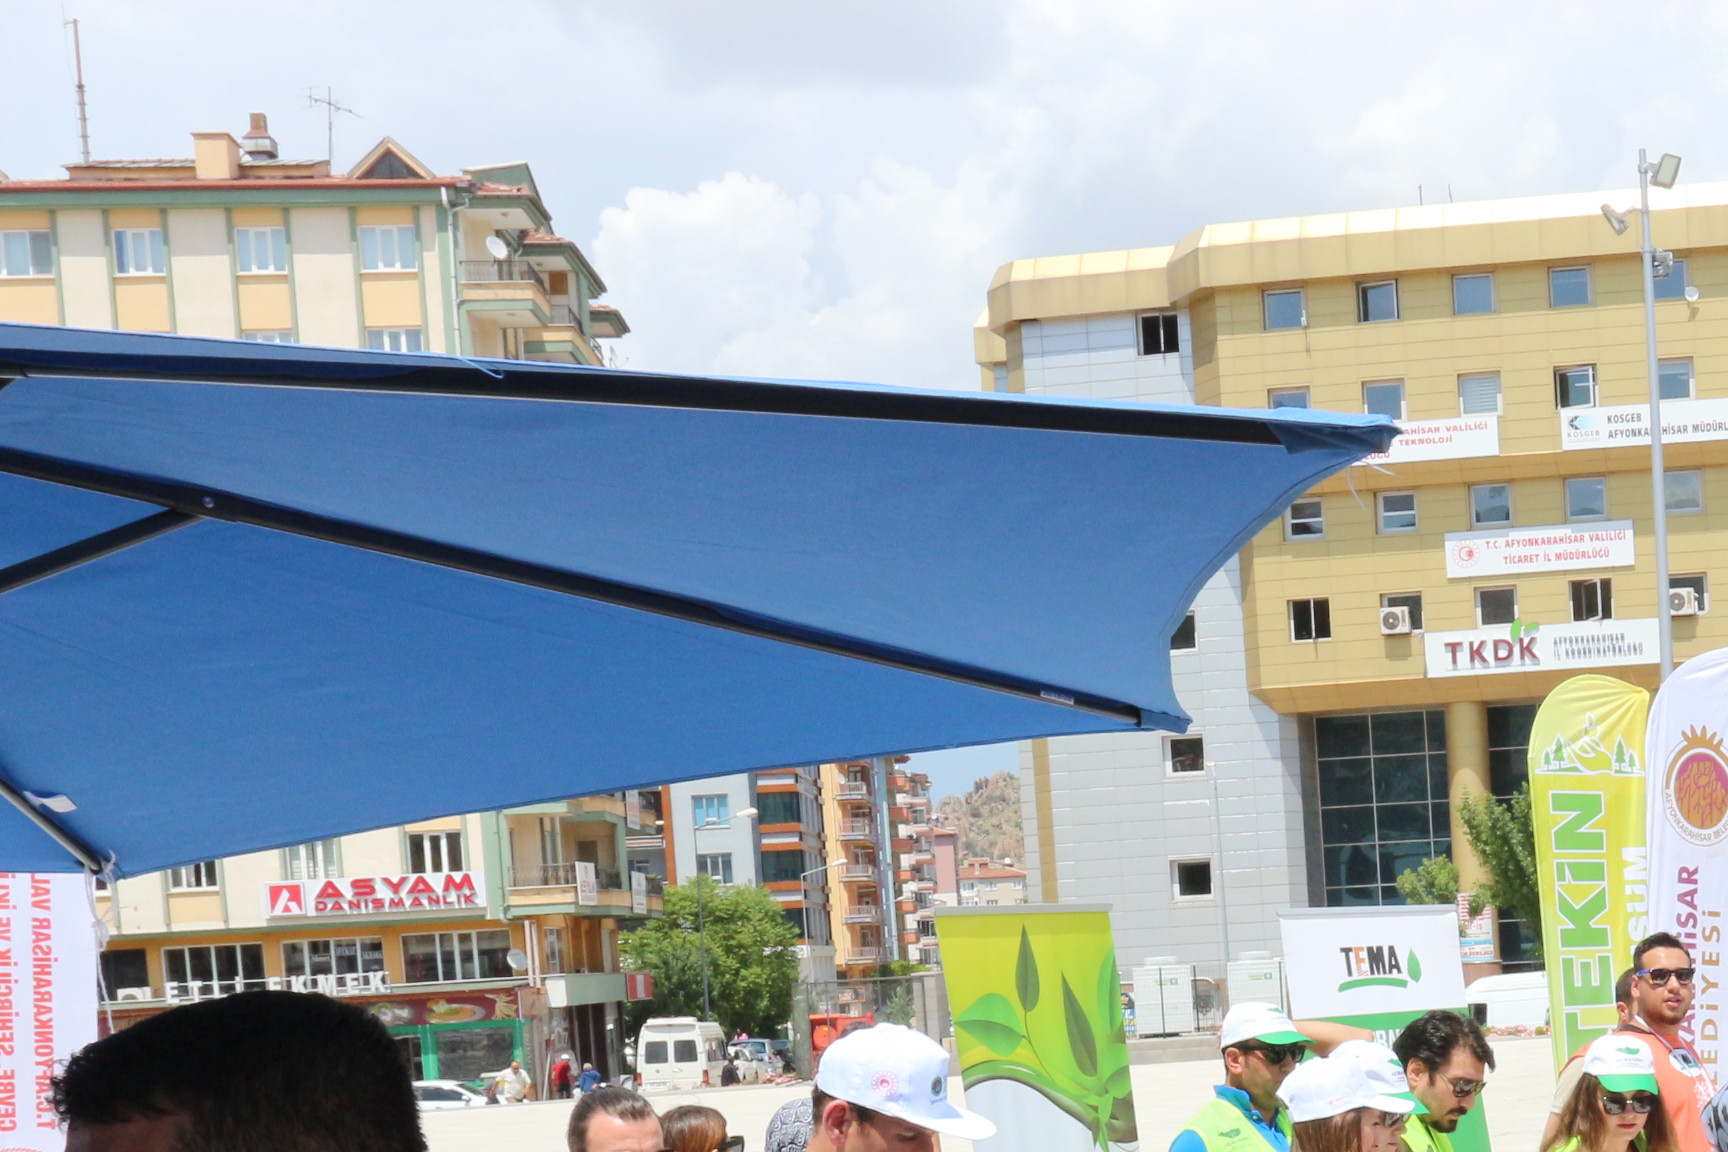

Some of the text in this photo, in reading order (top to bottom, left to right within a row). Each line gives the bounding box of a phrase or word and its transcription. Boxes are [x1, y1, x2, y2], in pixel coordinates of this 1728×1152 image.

[1607, 412, 1642, 424] KOSGEB
[1608, 421, 1689, 440] AFYONKAHİSAR
[1444, 637, 1540, 666] TKDK
[315, 873, 477, 899] ASYAM
[1340, 945, 1403, 978] TEMA
